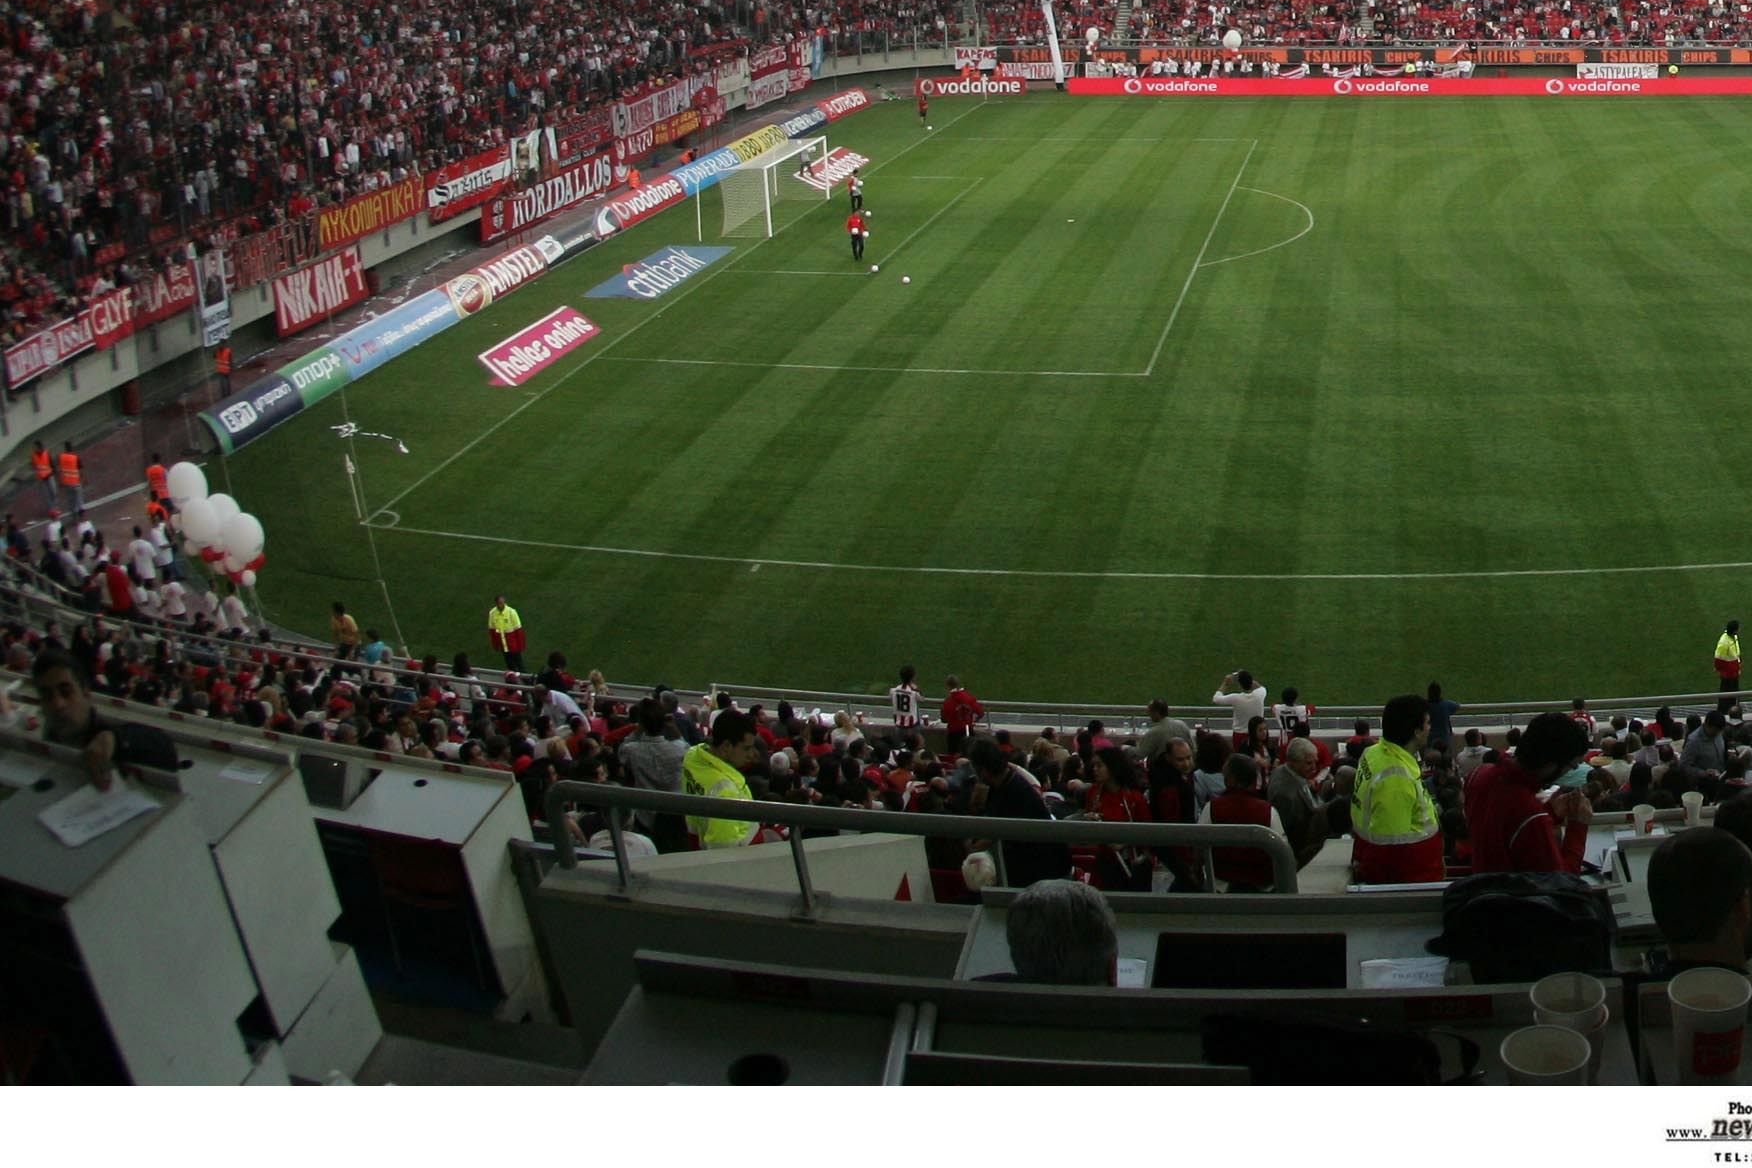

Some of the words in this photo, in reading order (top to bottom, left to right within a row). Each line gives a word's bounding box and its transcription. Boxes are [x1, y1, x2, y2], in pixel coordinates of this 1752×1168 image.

[1303, 49, 1372, 63] TSAKIRIS
[1455, 49, 1521, 63] SAKIRIS
[1535, 52, 1570, 63] CHIPS
[1600, 49, 1669, 63] TSAKIRIS
[1682, 51, 1719, 63] CHIPS
[936, 78, 1021, 94] vodafone
[1145, 80, 1218, 93] vodafone
[1356, 80, 1430, 93] vodafone
[1567, 80, 1641, 93] vodafone
[675, 148, 741, 189] POWERADE
[631, 176, 683, 213] vodafone
[478, 245, 545, 297] AMSTEL
[626, 247, 706, 298] citibank
[223, 406, 255, 430] ΕΡΤ
[896, 693, 911, 713] 18
